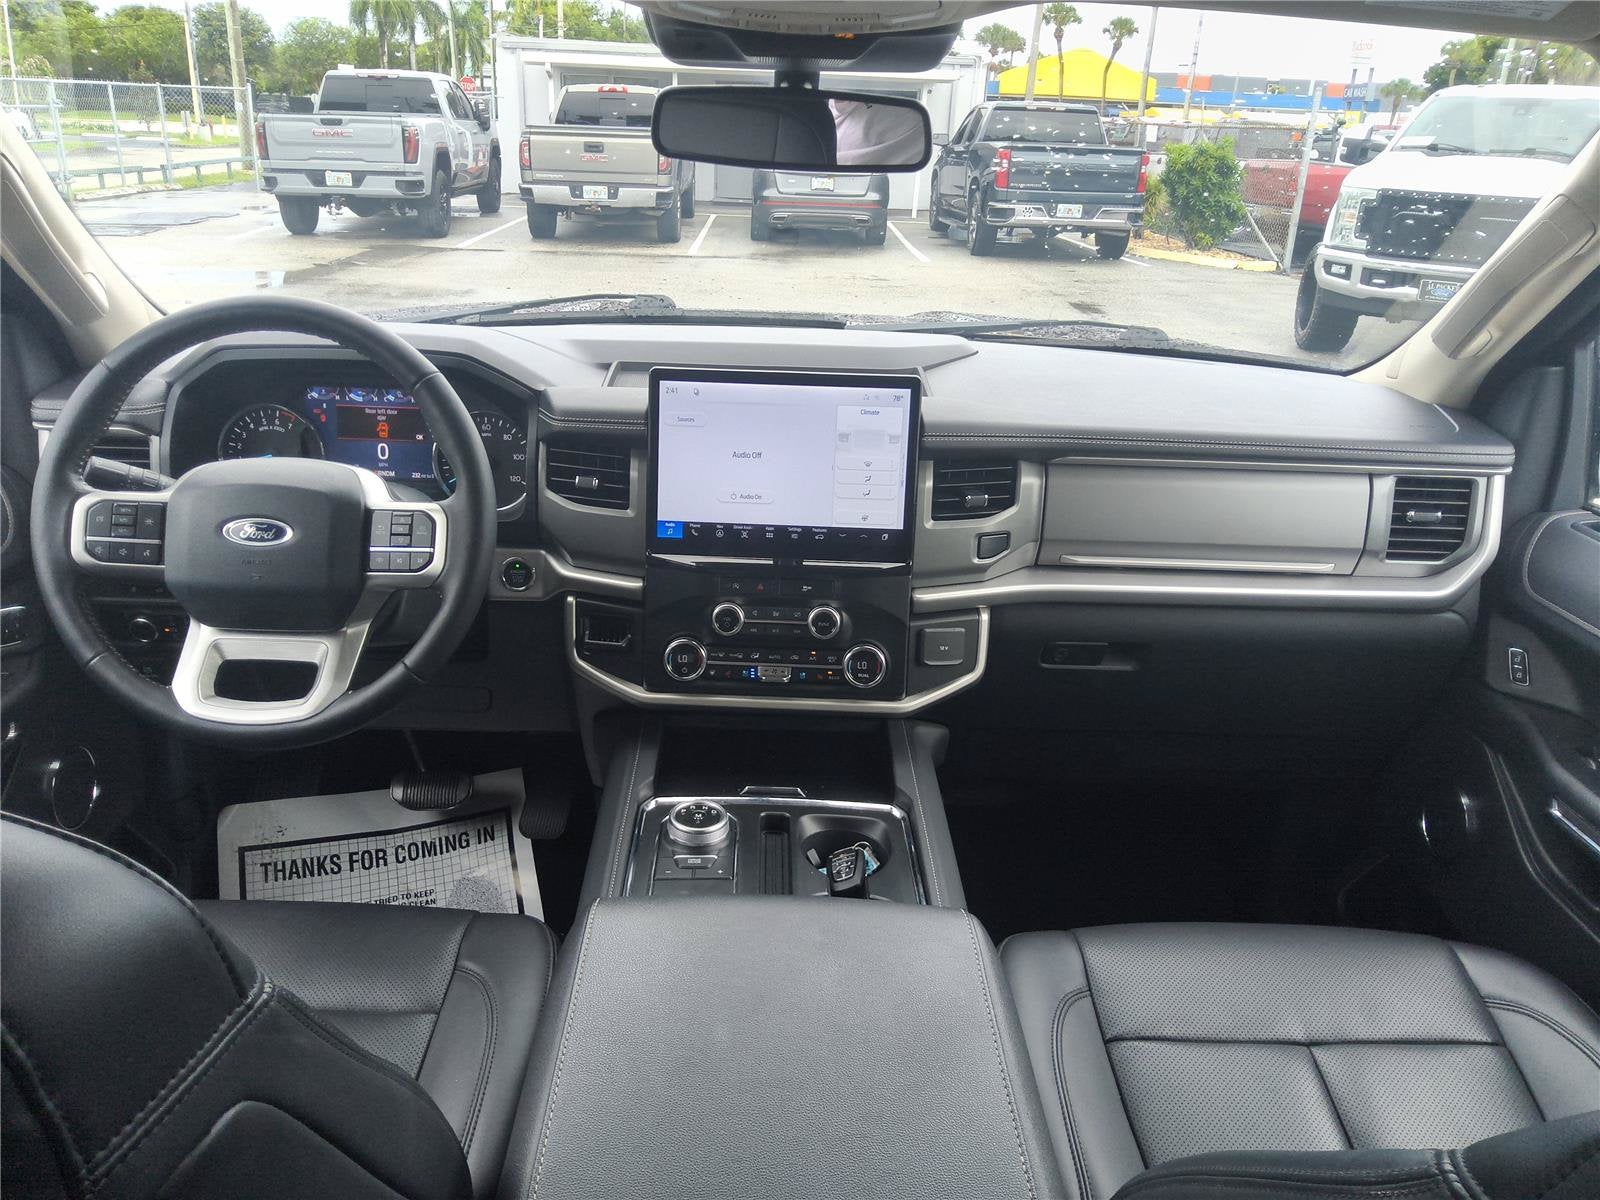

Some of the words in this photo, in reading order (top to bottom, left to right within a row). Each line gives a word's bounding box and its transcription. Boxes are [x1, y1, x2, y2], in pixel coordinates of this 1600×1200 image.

[312, 128, 354, 137] GMC
[665, 387, 679, 395] 2:41
[503, 433, 513, 441] 80
[377, 443, 389, 460] 0
[731, 451, 751, 459] Audio
[751, 451, 763, 459] Off
[240, 523, 277, 540] Ford
[678, 654, 688, 663] LO
[857, 661, 868, 670] LO
[260, 853, 342, 883] THANKS
[348, 848, 388, 873] FOR
[394, 831, 470, 864] COMING
[477, 824, 496, 845] IN
[400, 892, 412, 901] TO
[413, 888, 435, 899] KEEP
